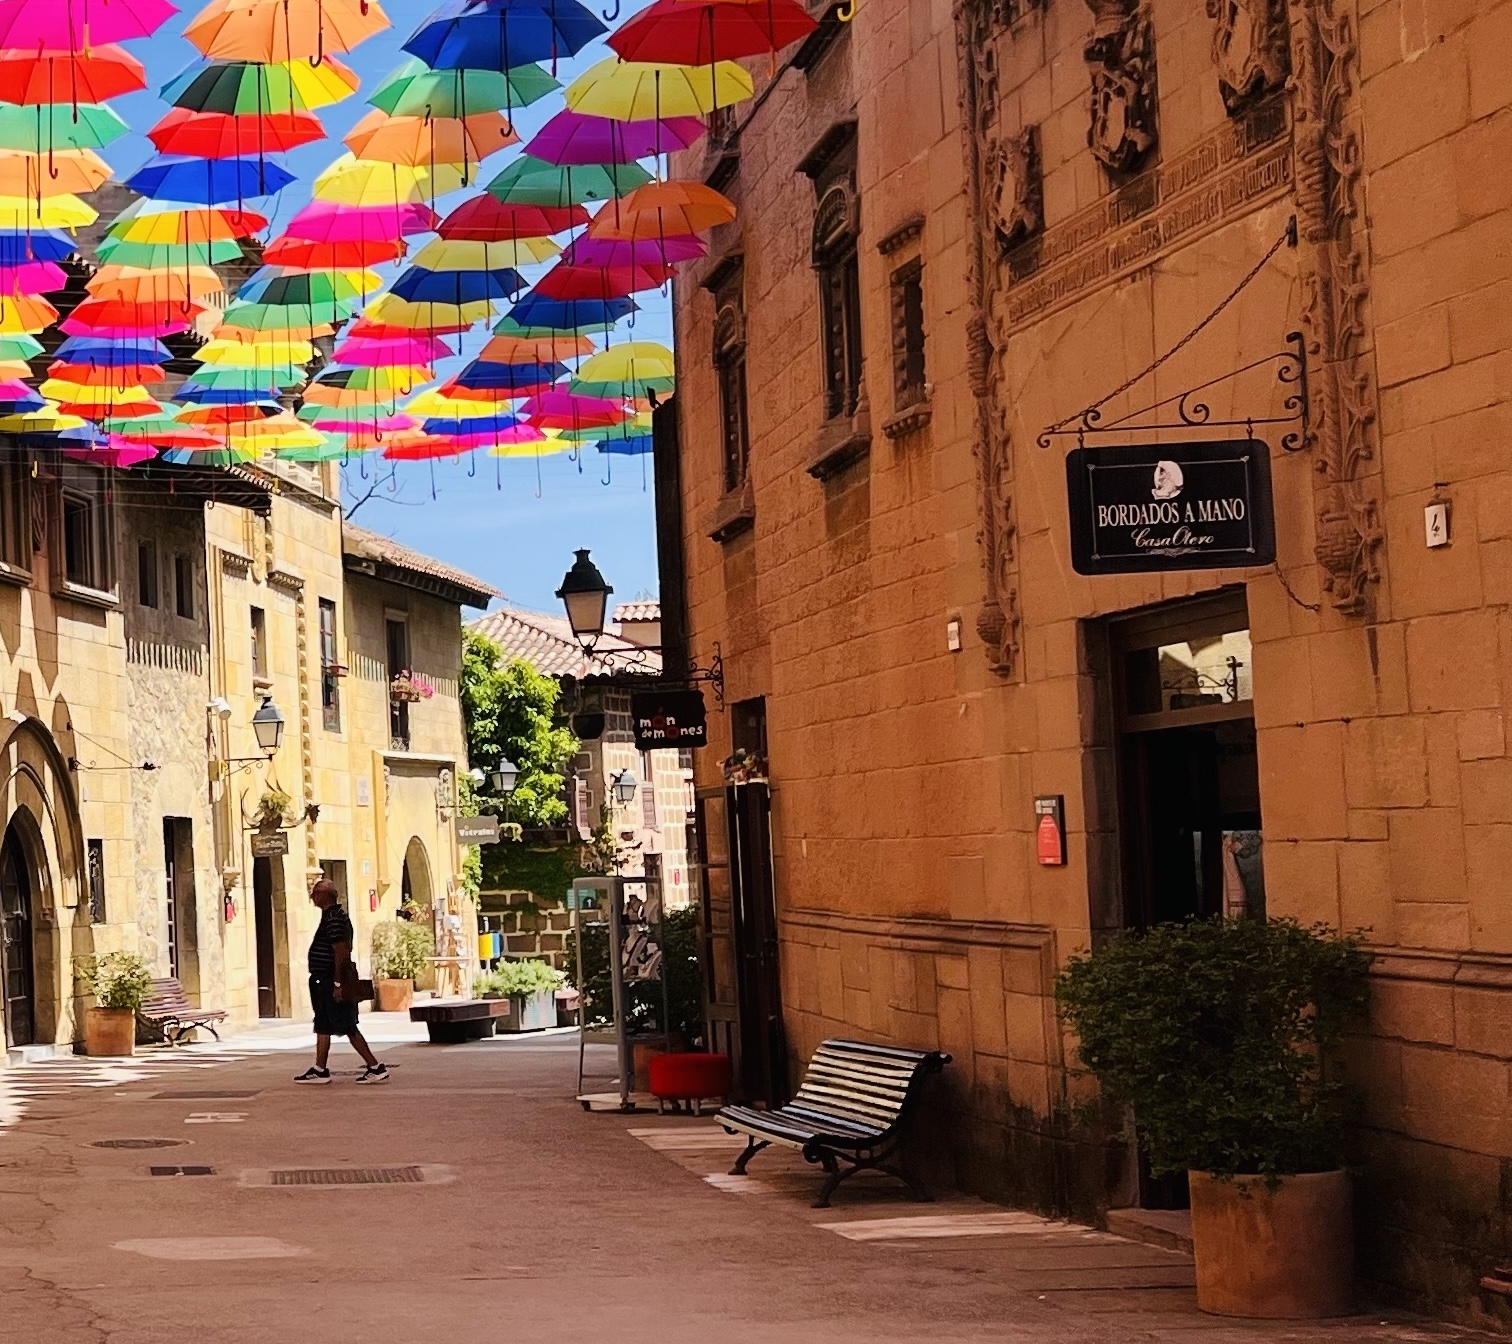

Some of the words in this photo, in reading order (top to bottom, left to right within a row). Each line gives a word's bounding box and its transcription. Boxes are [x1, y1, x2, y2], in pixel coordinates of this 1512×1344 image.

[1098, 502, 1179, 527] BORDADOS
[1185, 502, 1195, 523] A
[1198, 498, 1245, 522] MANO
[1131, 527, 1171, 547] Casa
